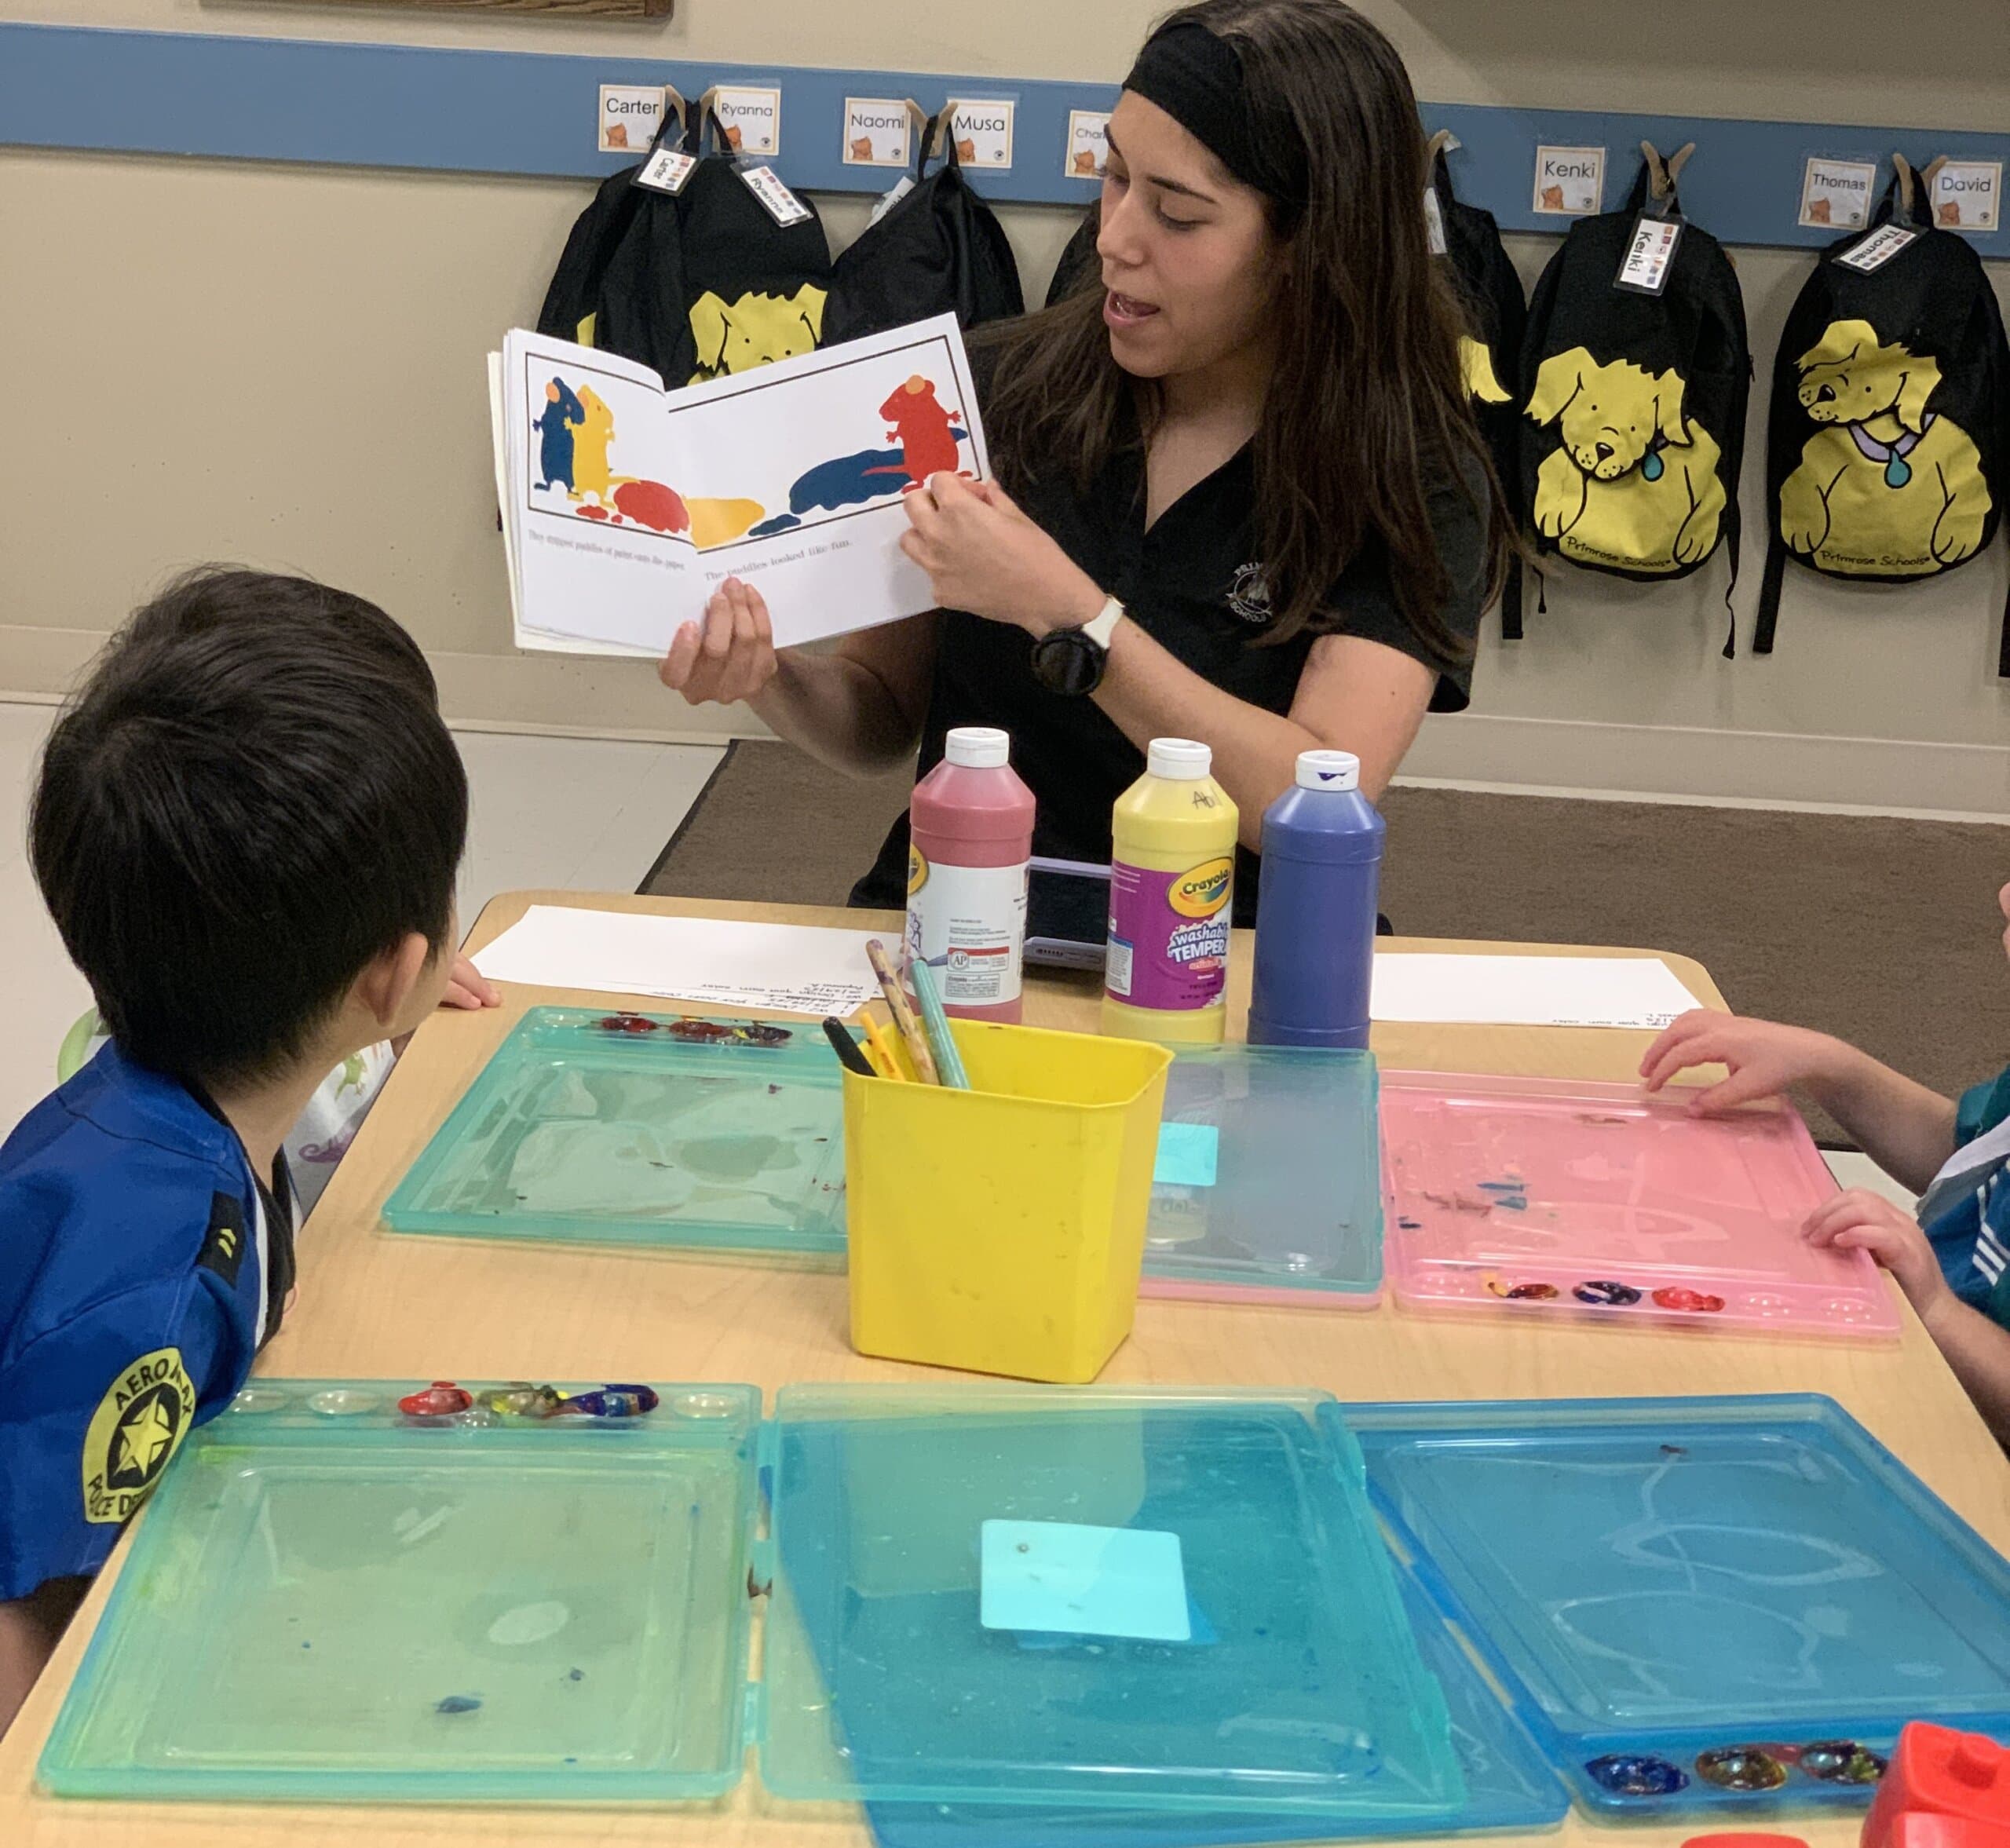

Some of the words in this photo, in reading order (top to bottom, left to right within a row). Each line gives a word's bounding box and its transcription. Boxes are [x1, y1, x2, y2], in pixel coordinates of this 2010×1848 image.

[606, 97, 660, 115] Carter
[721, 102, 773, 118] Ryanna
[850, 113, 905, 130] Naomi
[955, 115, 1006, 132] Musa
[656, 158, 674, 181] Carter
[1544, 159, 1596, 179] Kenki
[1812, 173, 1866, 192] Thomas
[1941, 177, 1991, 192] David
[751, 177, 784, 214] Ryanna
[1626, 230, 1654, 273] Kenki
[1850, 230, 1900, 264] Thomas
[1566, 535, 1620, 562] Primrose
[1819, 550, 1877, 565] Primrose
[727, 561, 769, 579] puddles
[770, 550, 806, 567] looked
[808, 545, 828, 557] like
[1182, 868, 1230, 895] Crayola
[1173, 939, 1226, 962] TEMPER
